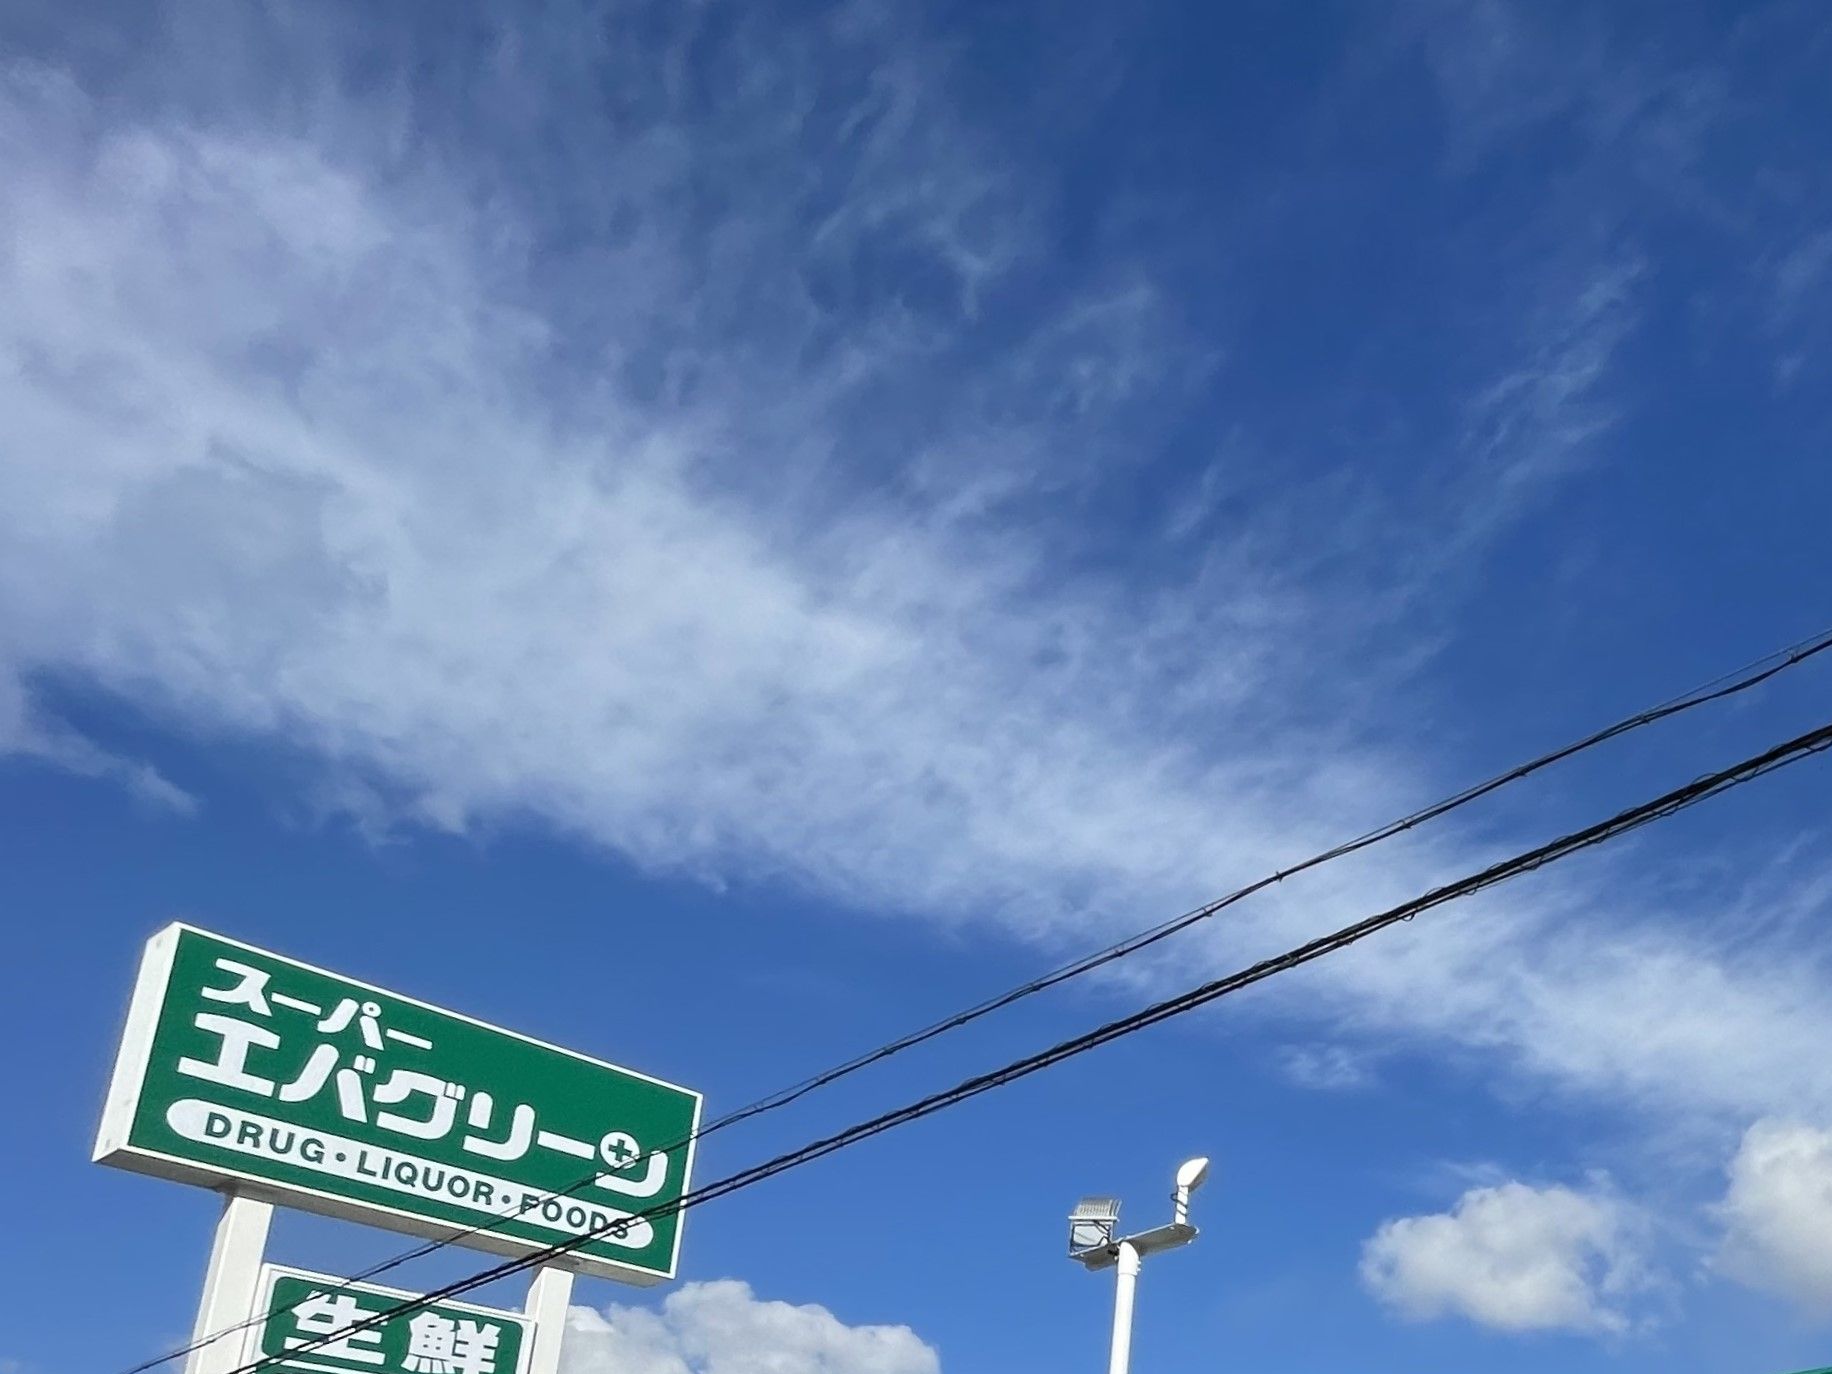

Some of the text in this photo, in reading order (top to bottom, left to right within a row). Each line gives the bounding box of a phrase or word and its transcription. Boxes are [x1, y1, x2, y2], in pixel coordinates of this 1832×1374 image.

[201, 957, 433, 1051] スーパー
[177, 1012, 669, 1198] エバグリーン
[204, 1112, 327, 1162] DRUG
[355, 1150, 495, 1206] LIQUOR
